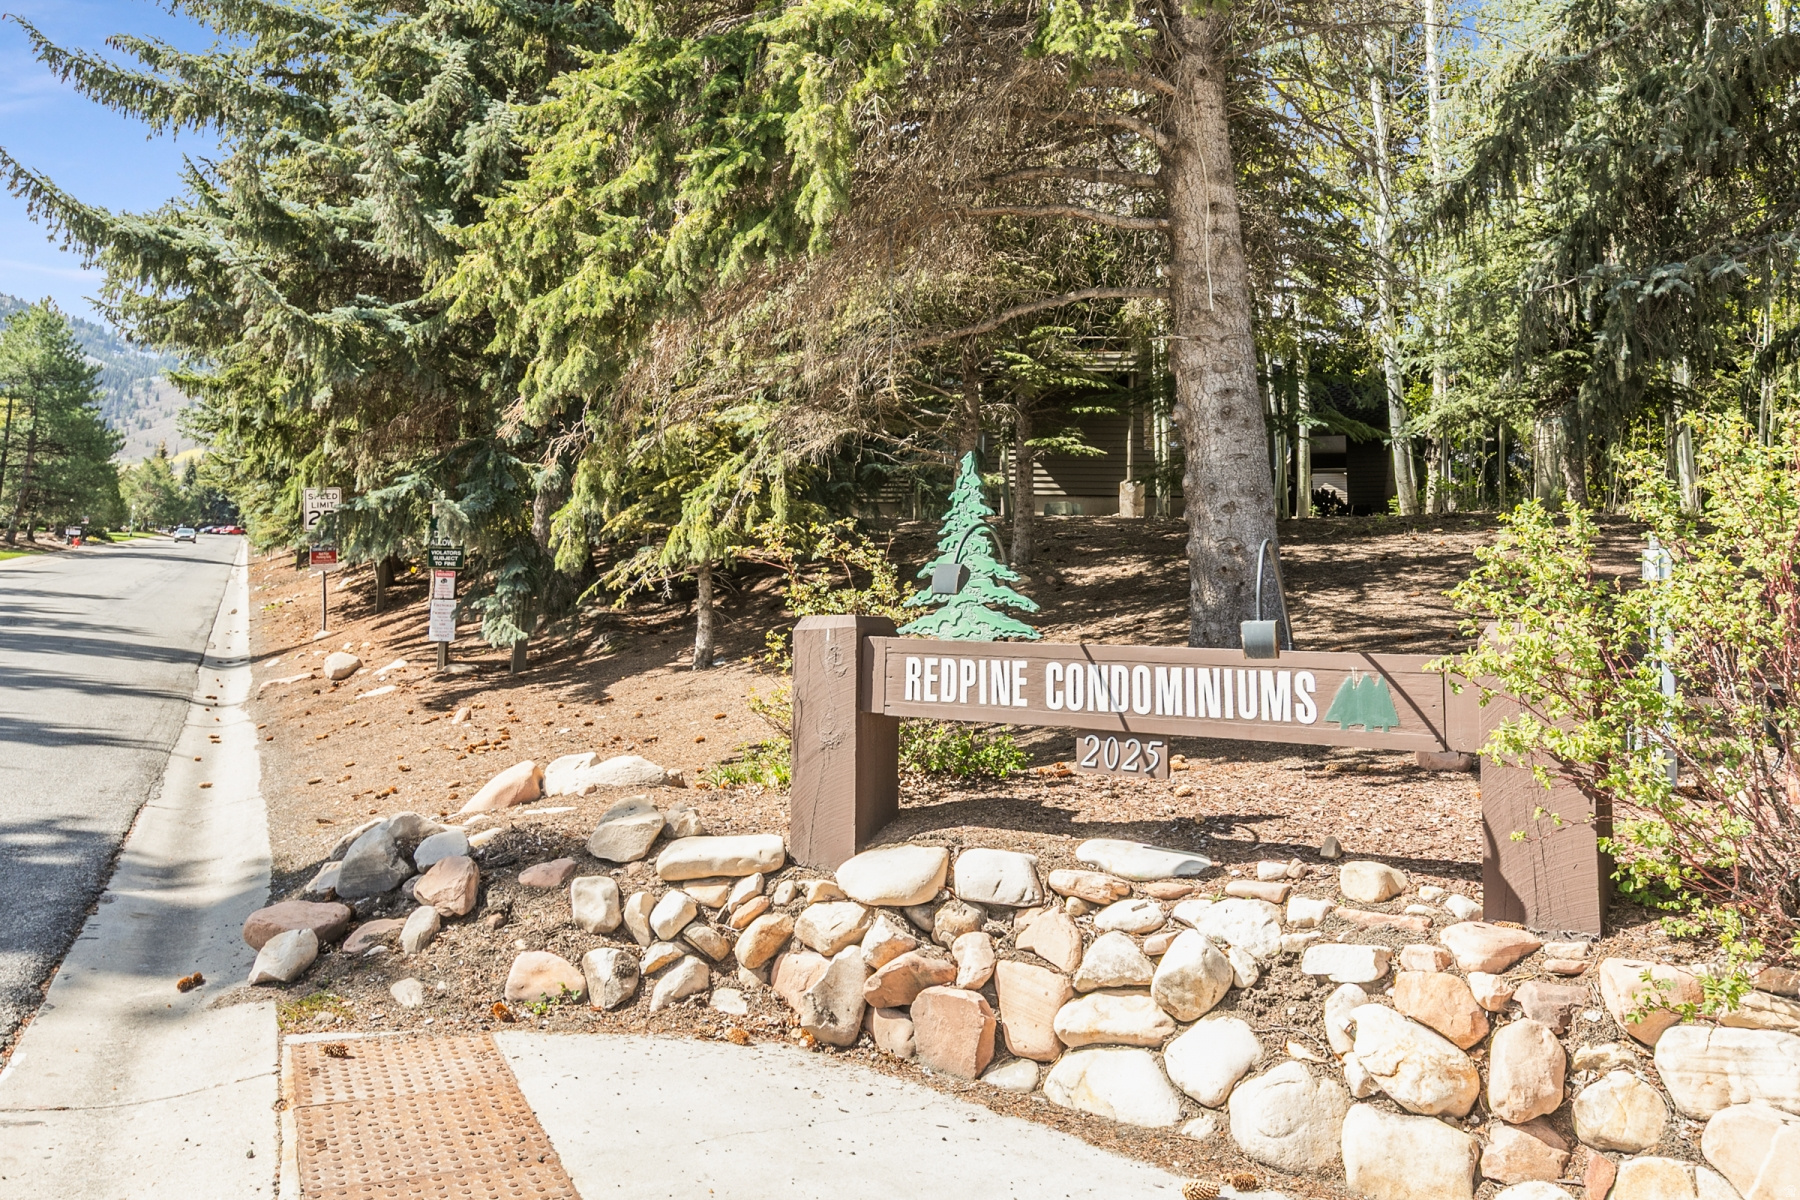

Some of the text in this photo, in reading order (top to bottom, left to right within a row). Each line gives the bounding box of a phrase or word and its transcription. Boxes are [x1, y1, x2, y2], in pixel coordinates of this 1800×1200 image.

[904, 656, 1318, 725] REDPINE CONDOMINIUMS
[1080, 734, 1163, 773] 2025
